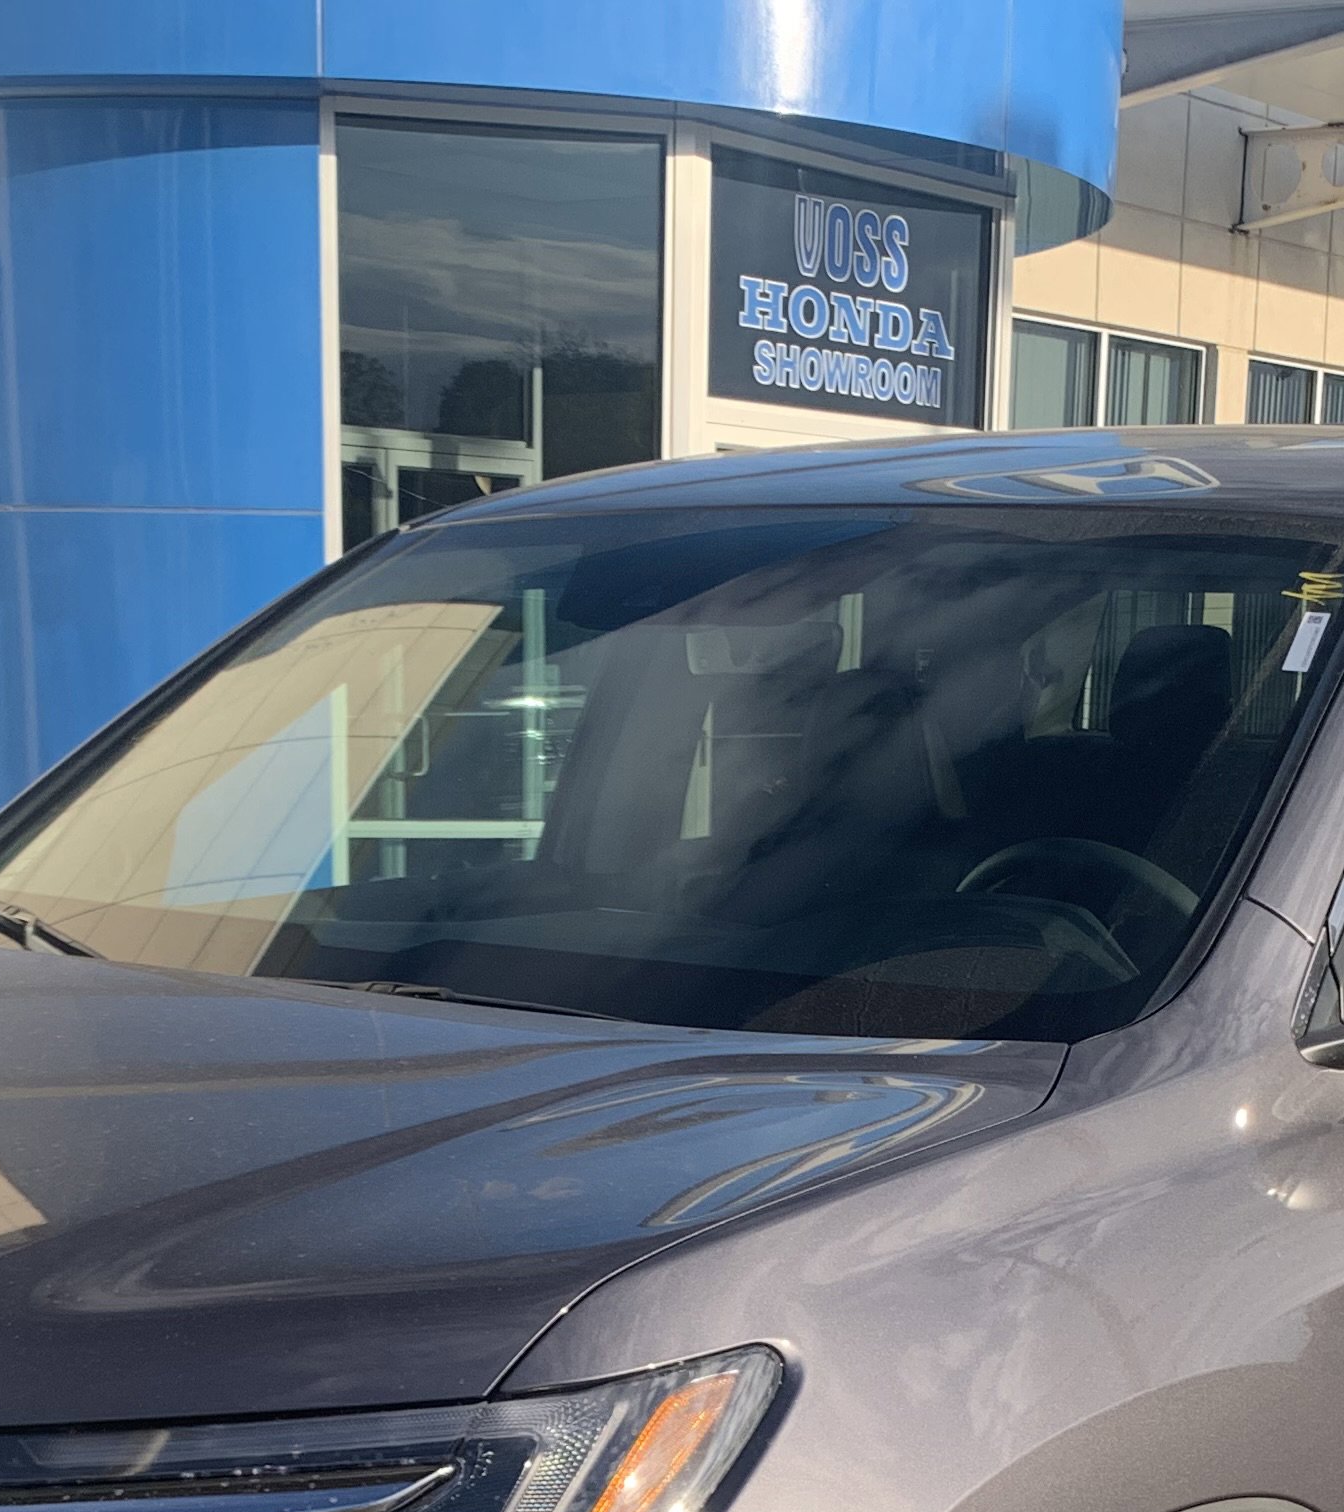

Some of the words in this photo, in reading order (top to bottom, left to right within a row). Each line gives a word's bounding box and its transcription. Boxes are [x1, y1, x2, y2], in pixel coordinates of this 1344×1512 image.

[794, 194, 909, 293] VOSS
[739, 275, 955, 361] HONDA
[753, 340, 941, 408] SHOWROOM
